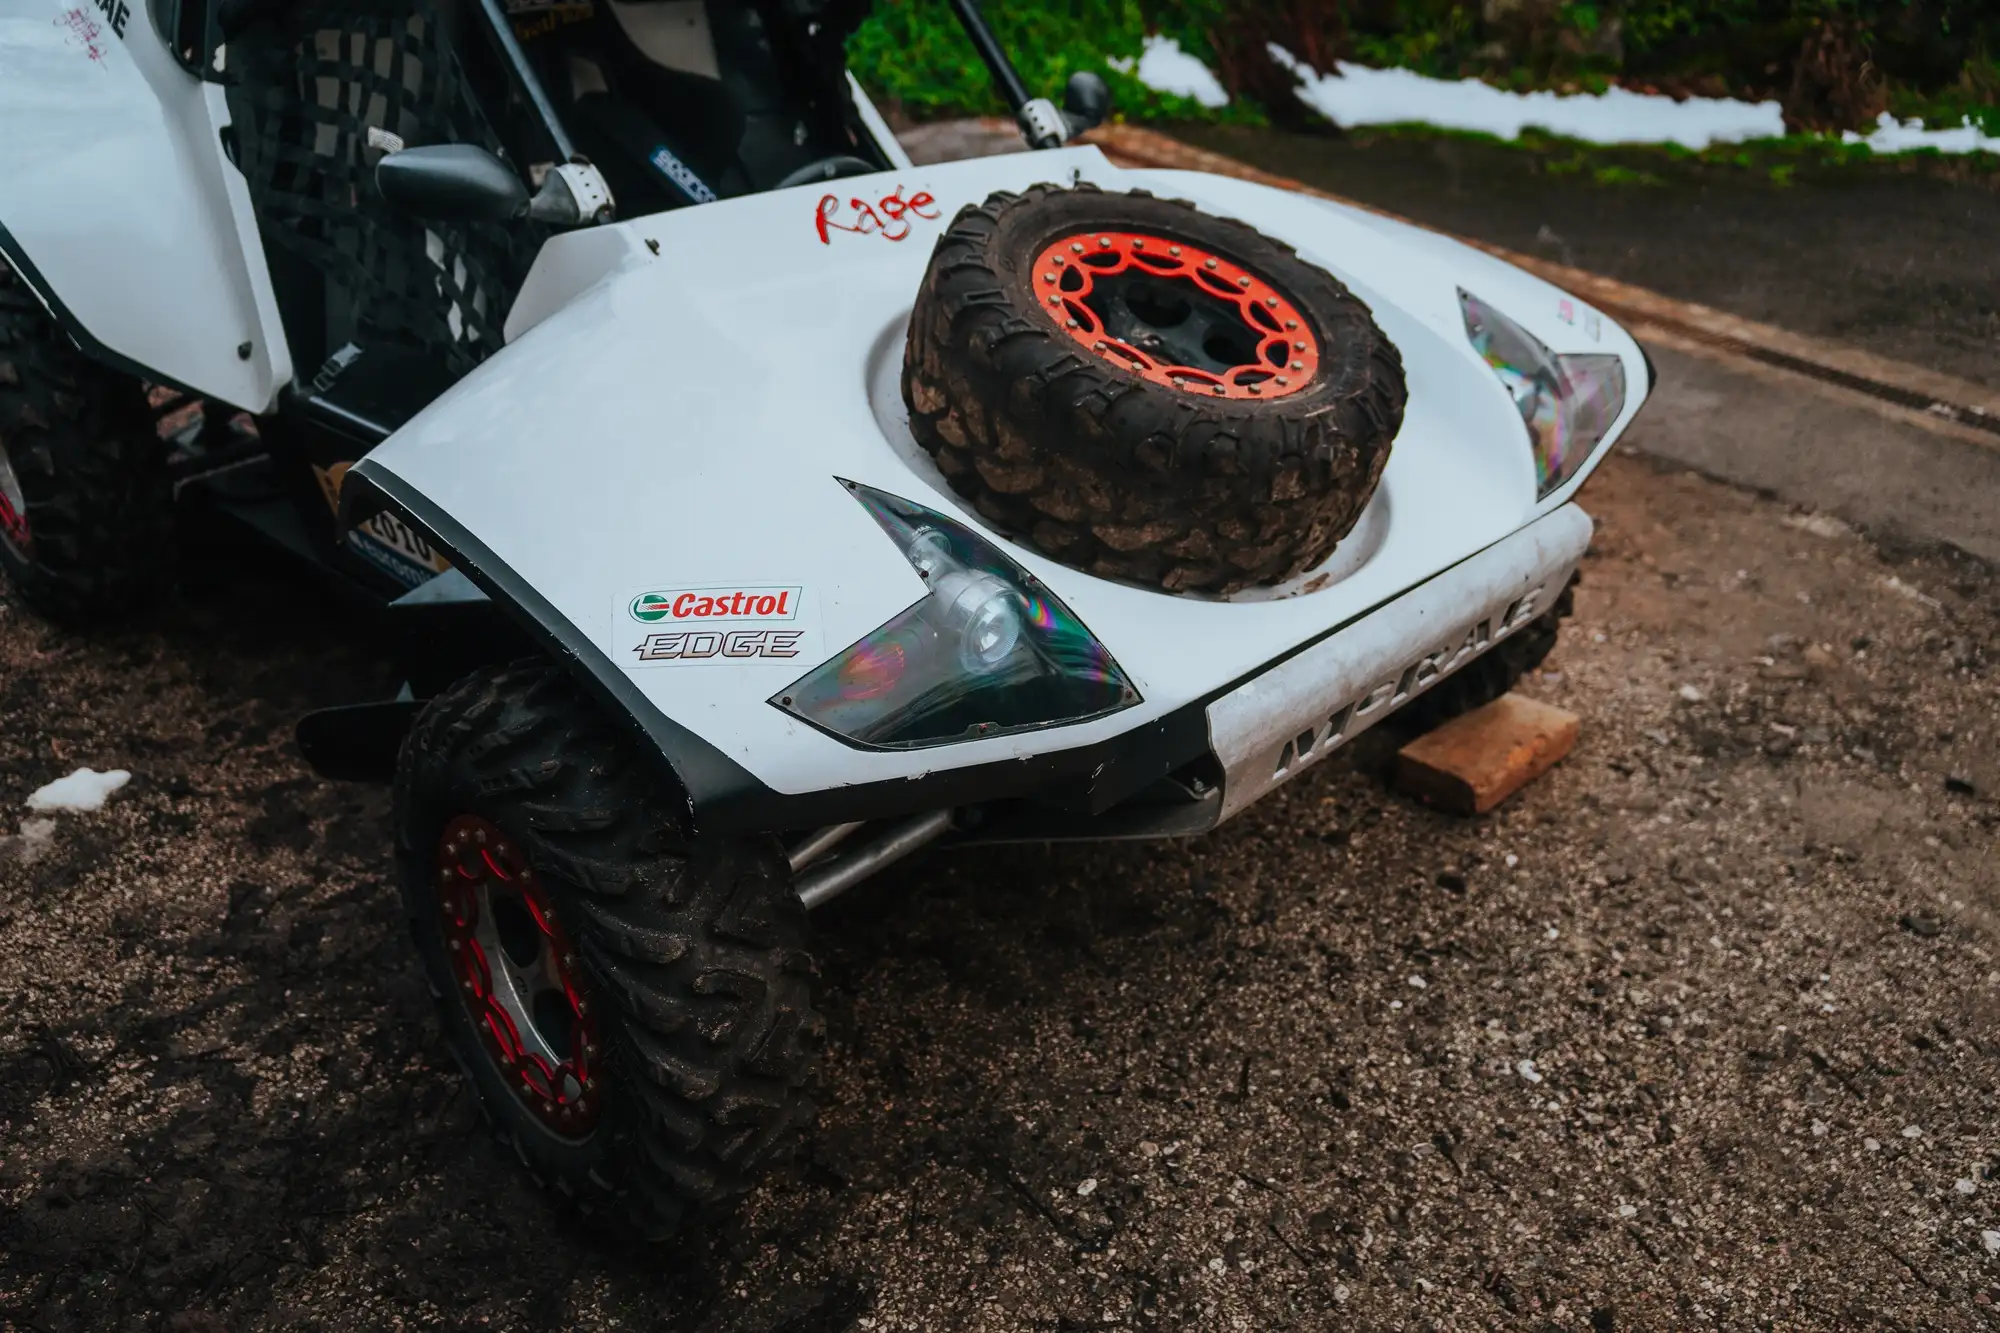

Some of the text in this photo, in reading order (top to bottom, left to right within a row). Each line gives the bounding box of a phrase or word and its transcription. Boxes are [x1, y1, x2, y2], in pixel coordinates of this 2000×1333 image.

[816, 184, 941, 245] Rage
[672, 590, 789, 619] Castrol
[632, 630, 805, 661] EDGE
